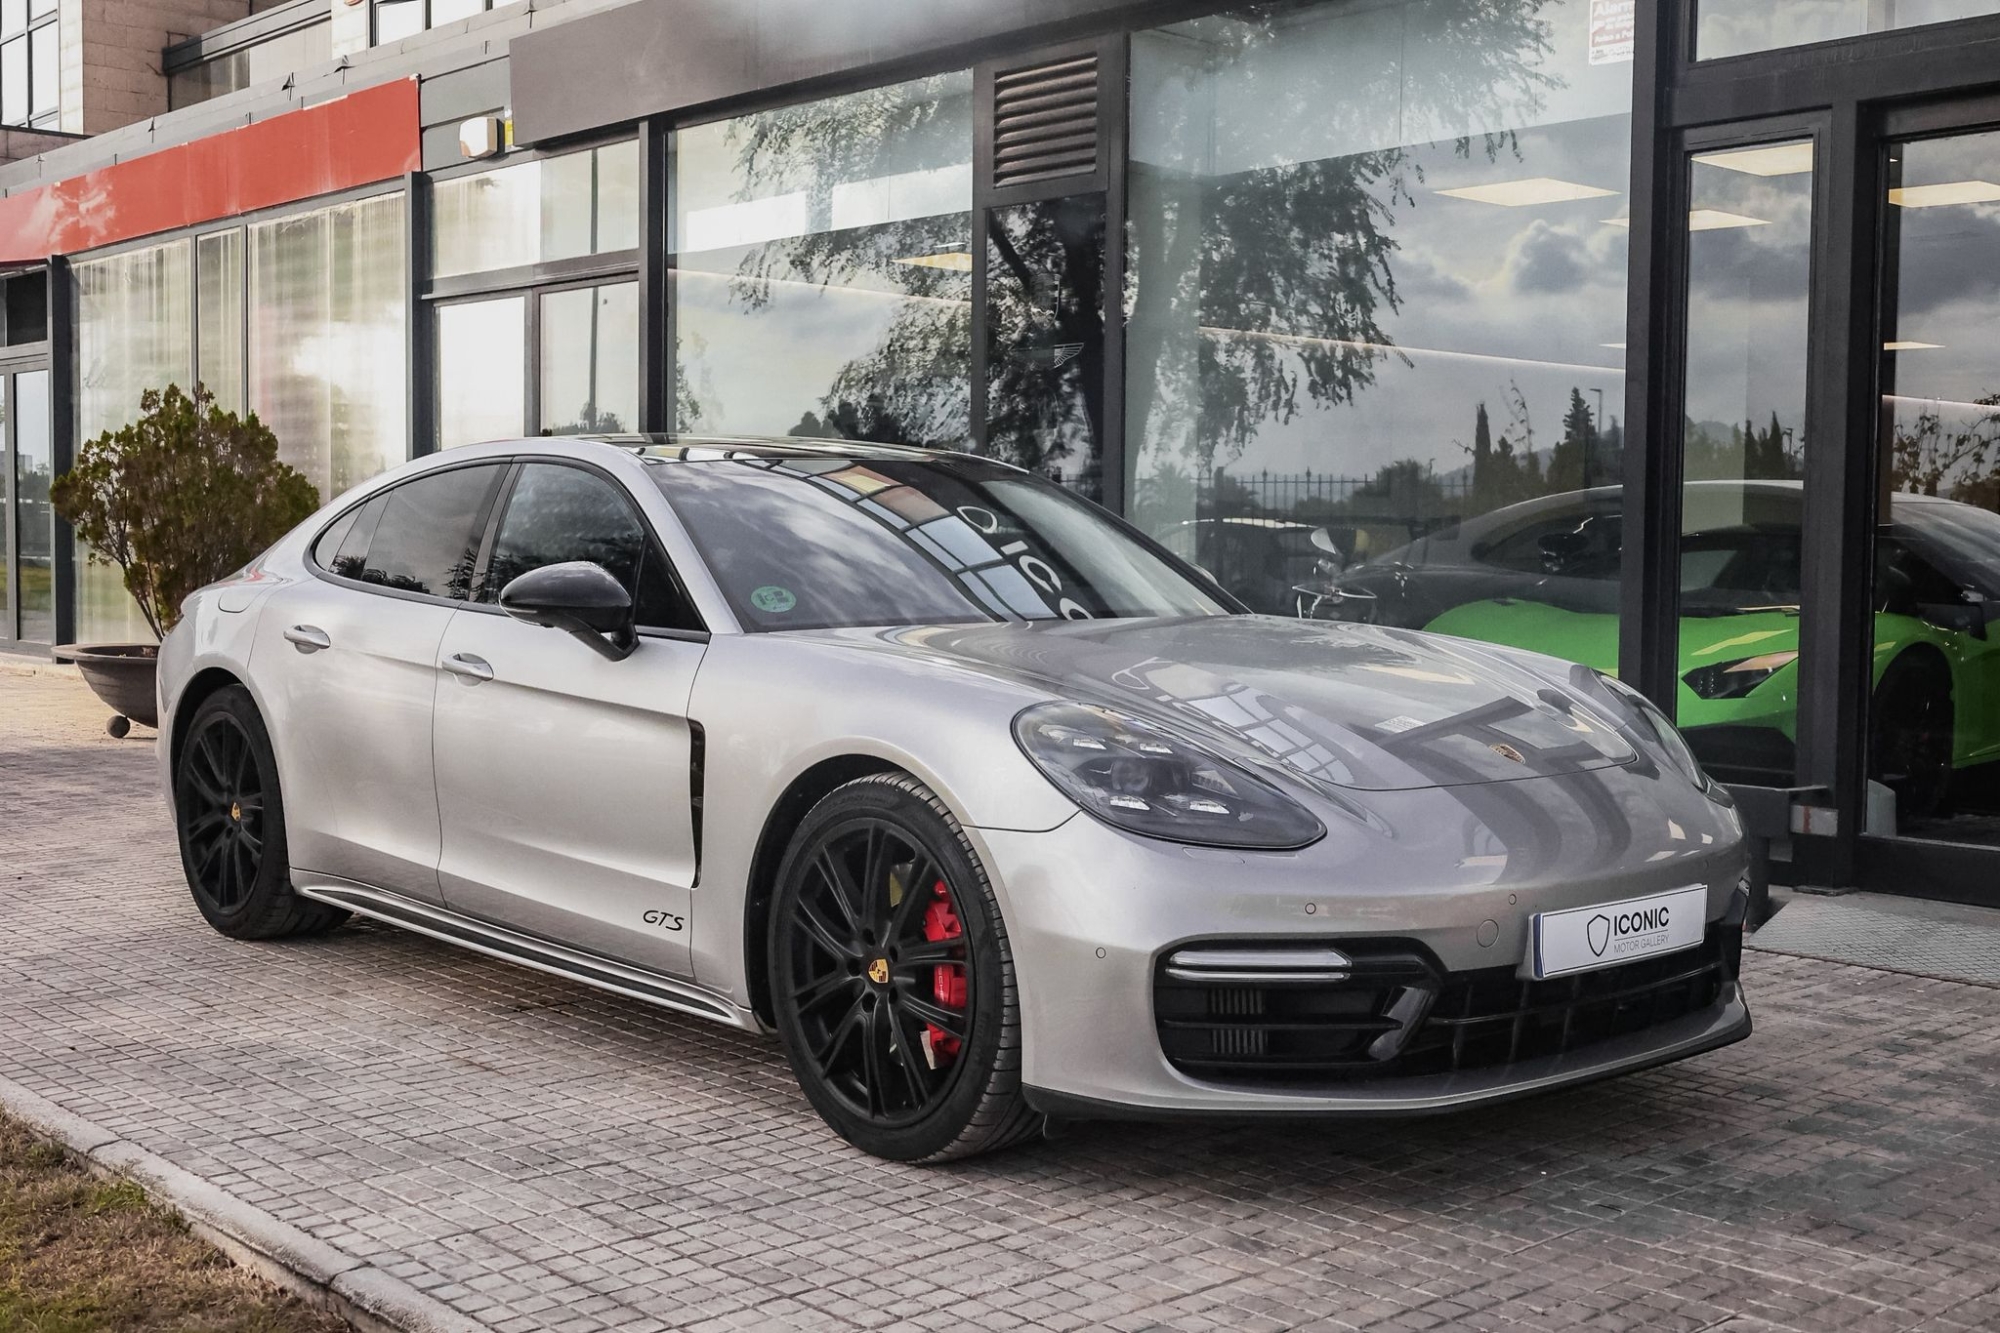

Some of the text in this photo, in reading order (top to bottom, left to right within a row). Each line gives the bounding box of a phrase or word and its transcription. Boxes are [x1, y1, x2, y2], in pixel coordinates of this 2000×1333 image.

[643, 910, 685, 931] GTS
[1614, 907, 1669, 936] ICONIC
[1614, 935, 1669, 953] MOTOR GALLERY
